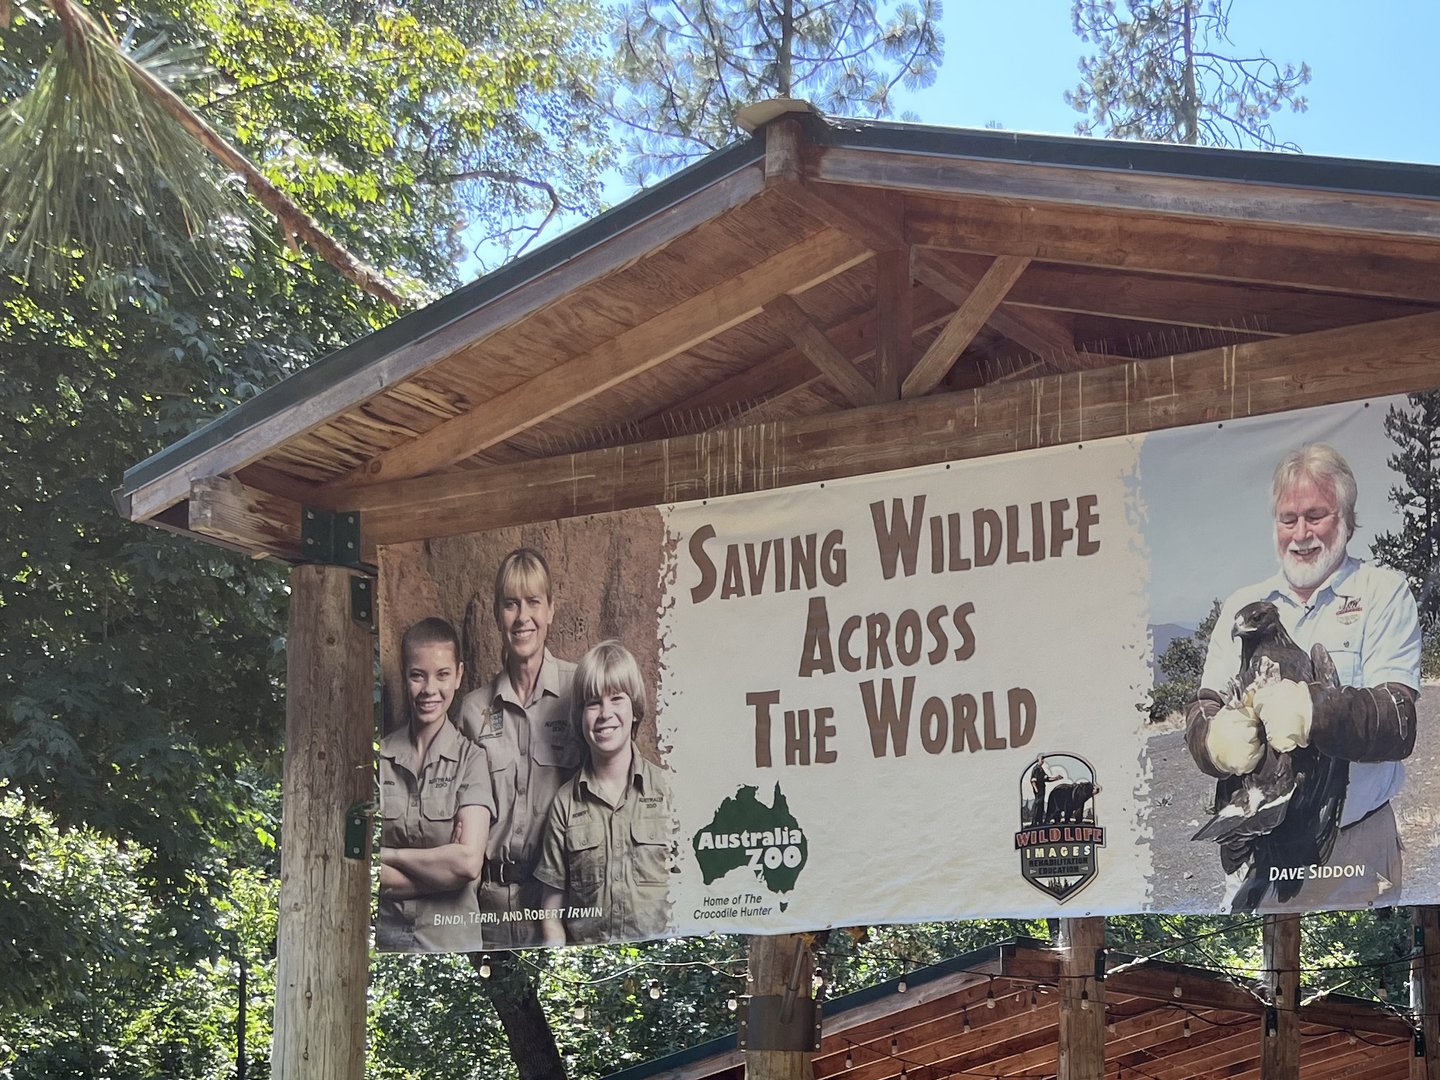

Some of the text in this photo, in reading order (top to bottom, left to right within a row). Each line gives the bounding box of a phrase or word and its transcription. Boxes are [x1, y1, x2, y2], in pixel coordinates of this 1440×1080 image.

[688, 494, 1101, 604] SAVING WILDLIFE
[798, 596, 976, 677] ACROSS
[746, 676, 1037, 768] THE WORLD
[698, 826, 802, 850] Australia
[1016, 827, 1103, 846] WILDLIFE
[1026, 845, 1091, 859] IMAGES
[1038, 865, 1079, 875] EDUCATION
[1269, 864, 1365, 881] DAVE SIDDON
[703, 894, 762, 907] Home of The
[434, 906, 603, 926] BINDI, TERRI, AND ROBERT IRWIN
[693, 906, 772, 920] Crocodile Hunter
